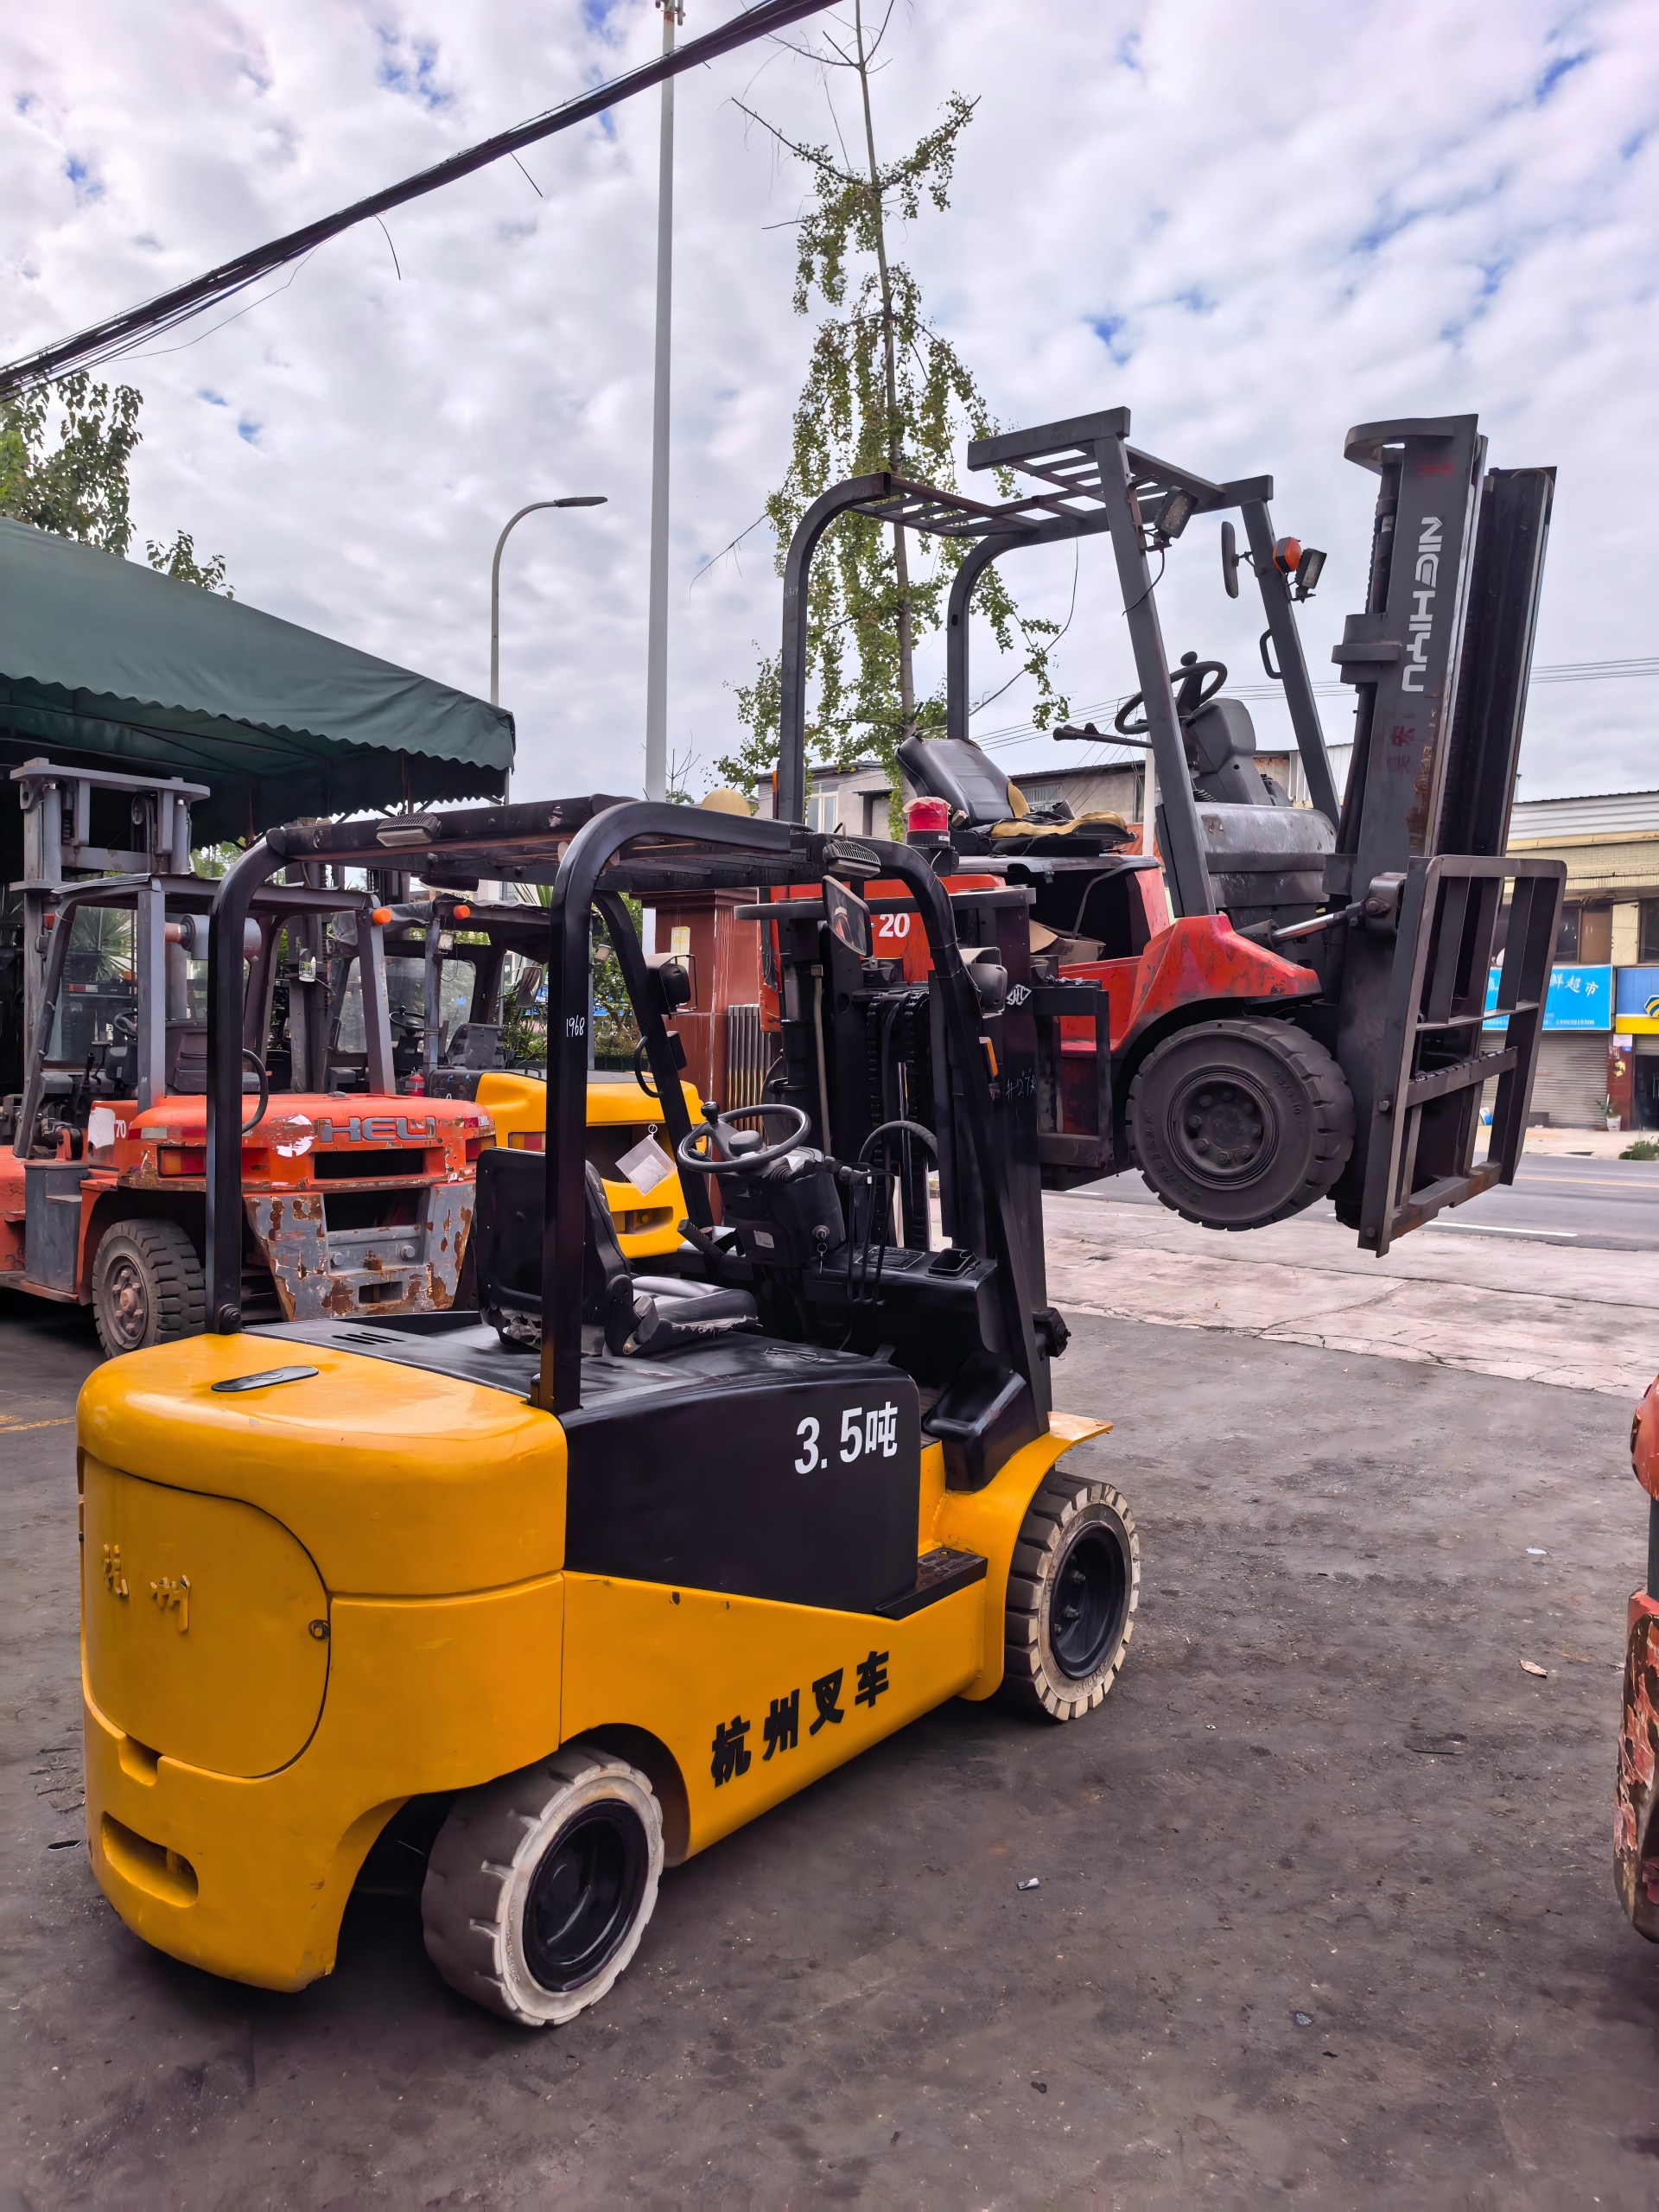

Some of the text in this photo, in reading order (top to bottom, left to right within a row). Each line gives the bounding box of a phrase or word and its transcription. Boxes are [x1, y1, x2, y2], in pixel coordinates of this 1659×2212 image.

[1402, 517, 1443, 692] NICHIYU
[566, 1014, 585, 1037] 1968
[319, 1116, 435, 1142] HELI
[710, 1650, 889, 1788] 杭州叉车
